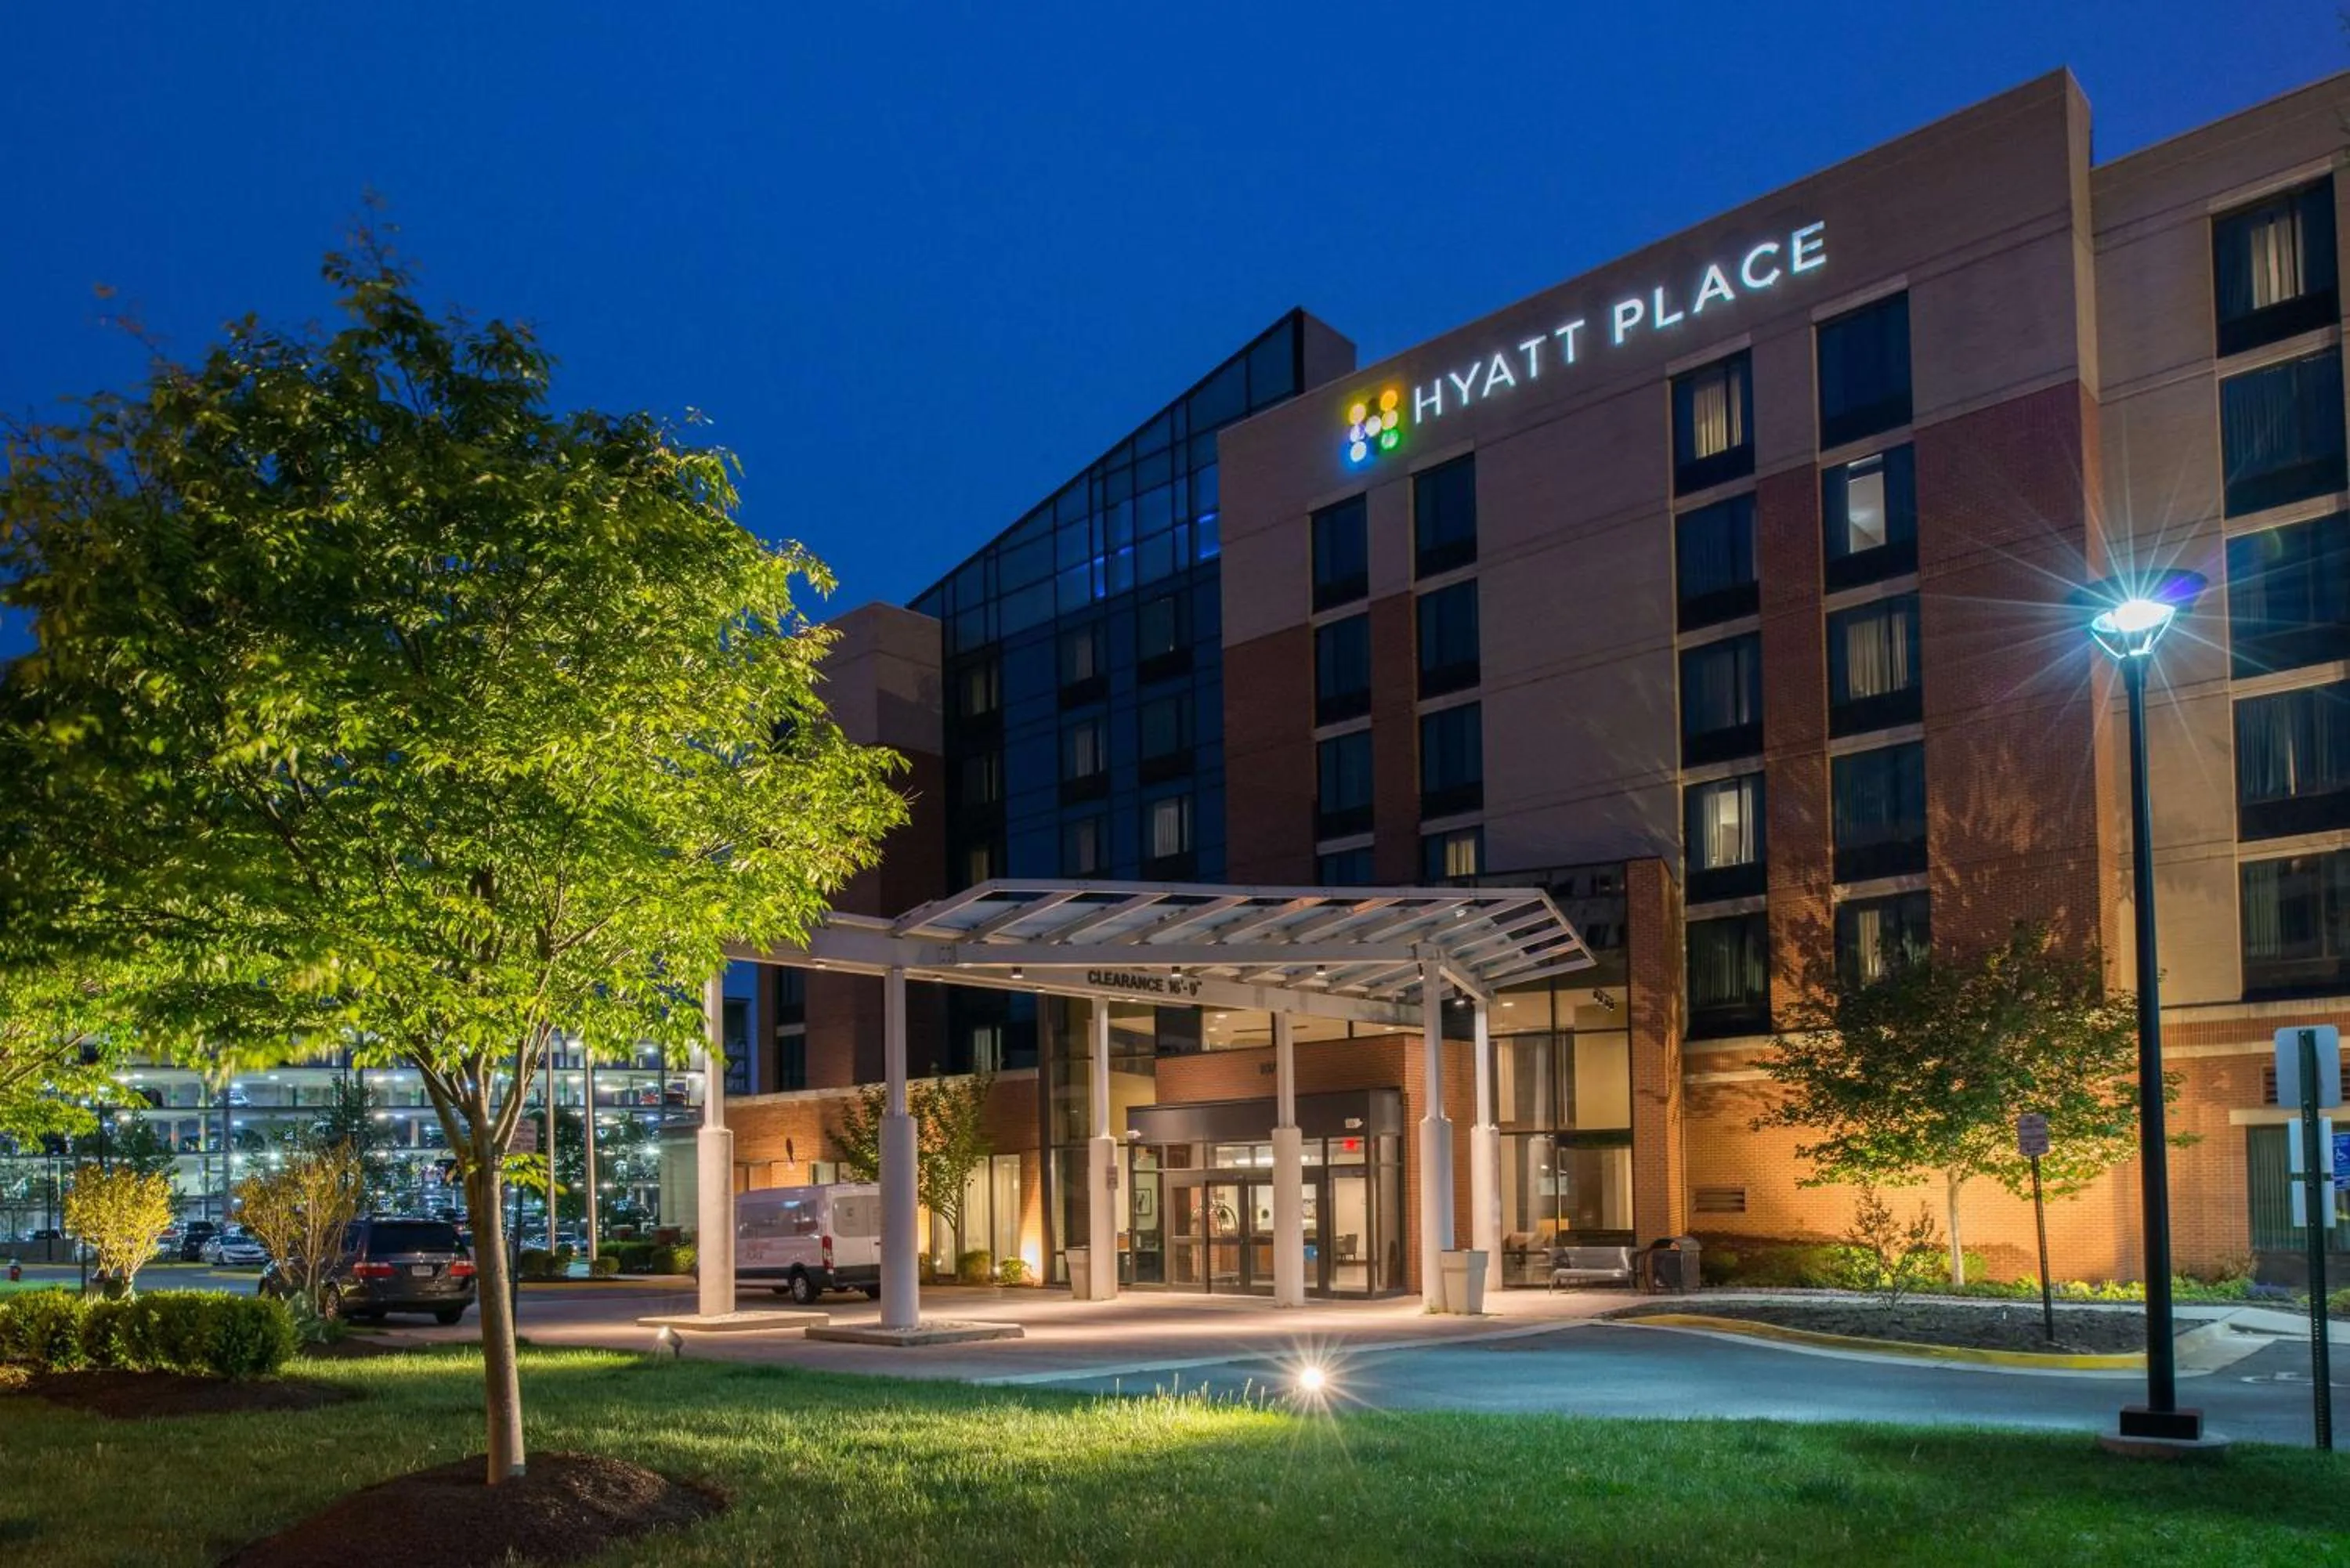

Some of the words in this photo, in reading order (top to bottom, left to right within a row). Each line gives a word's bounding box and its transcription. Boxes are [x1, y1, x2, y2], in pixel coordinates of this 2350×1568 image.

[1414, 319, 1585, 424] HYATT
[1614, 221, 1828, 345] PLACE
[1087, 970, 1163, 992] CLEARANCE
